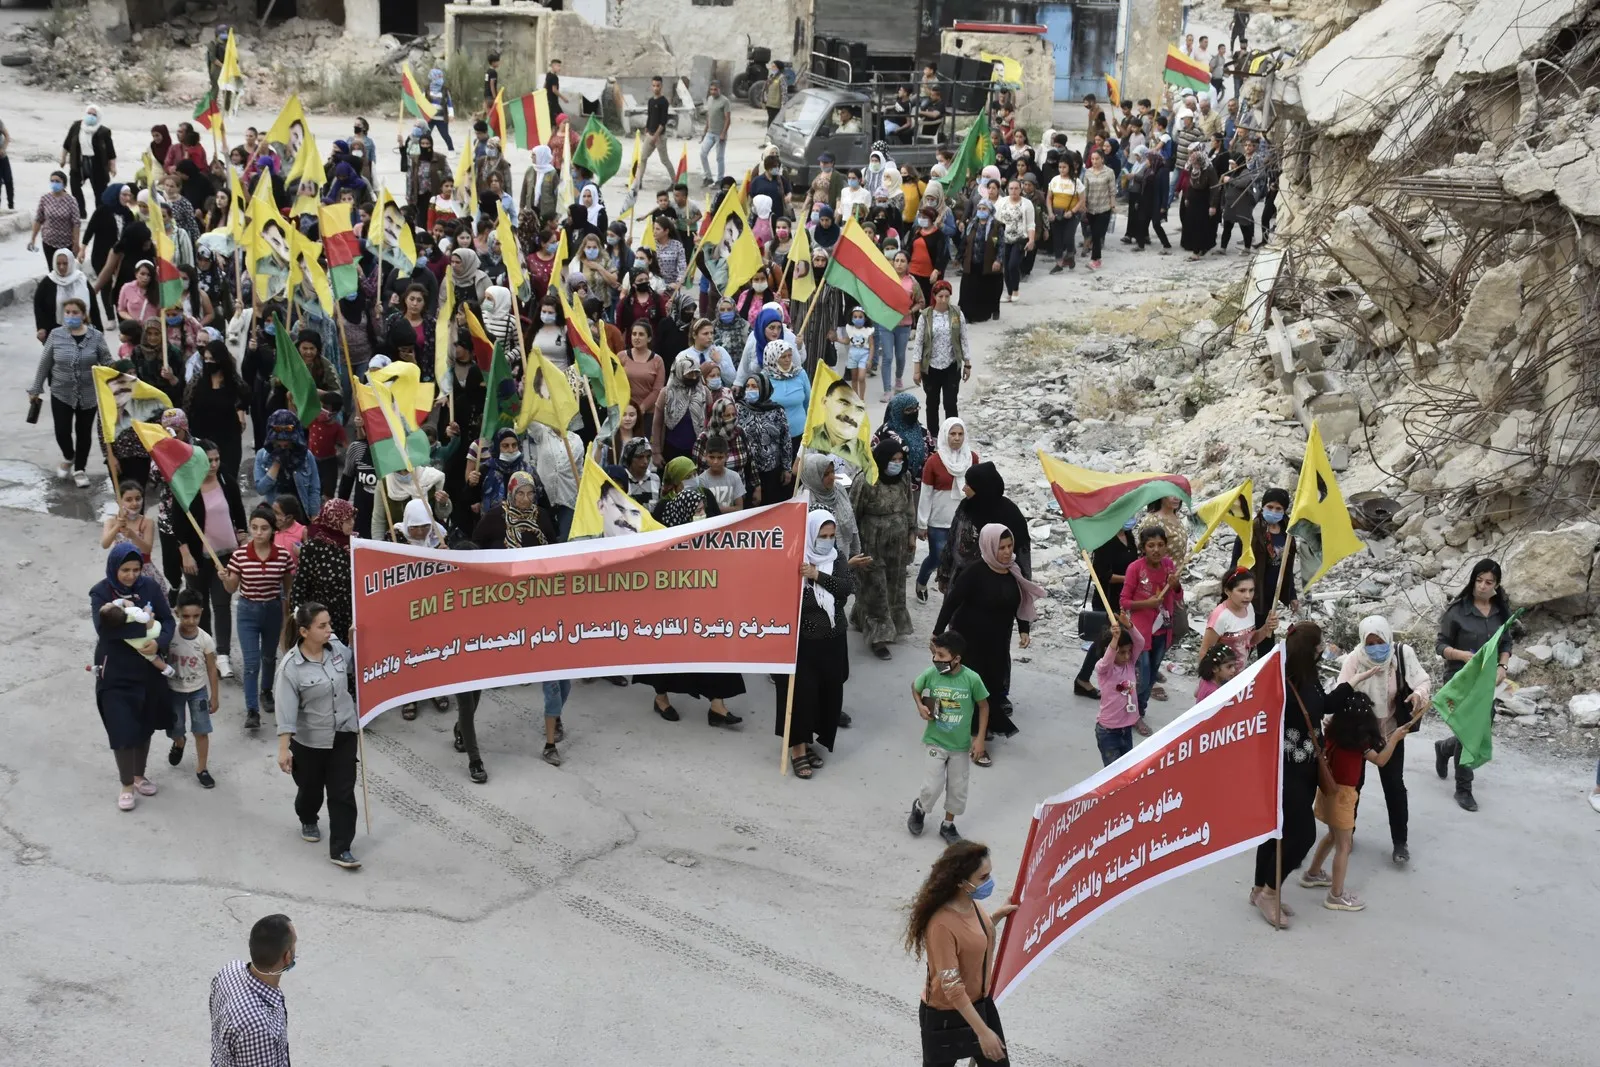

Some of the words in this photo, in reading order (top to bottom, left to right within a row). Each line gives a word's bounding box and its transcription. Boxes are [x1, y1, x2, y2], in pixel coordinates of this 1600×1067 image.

[667, 525, 784, 550] EVKARIYÊ
[364, 572, 380, 596] LI
[409, 599, 438, 621] EM
[443, 588, 455, 612] Ê
[459, 572, 566, 608] TEKOŞÎNÊ
[572, 571, 650, 594] BILIND
[655, 569, 718, 590] BIKIN
[464, 628, 526, 652] الهجمات
[529, 620, 563, 649] أمام
[567, 620, 629, 644] والنضال
[633, 617, 688, 640] المقاومة
[693, 617, 734, 639] وتيرة
[738, 617, 791, 639] سنرفع
[404, 638, 460, 668] الوحشية
[1178, 738, 1193, 762] BI
[1199, 710, 1268, 754] BINKEVÊ
[1138, 788, 1183, 823] مقاومة
[1087, 812, 1135, 859] حفتانين
[1149, 821, 1210, 862] وستسقط
[1104, 842, 1146, 883] الخيانة
[1056, 869, 1102, 920] والفاشية
[1022, 901, 1055, 954] التركية
